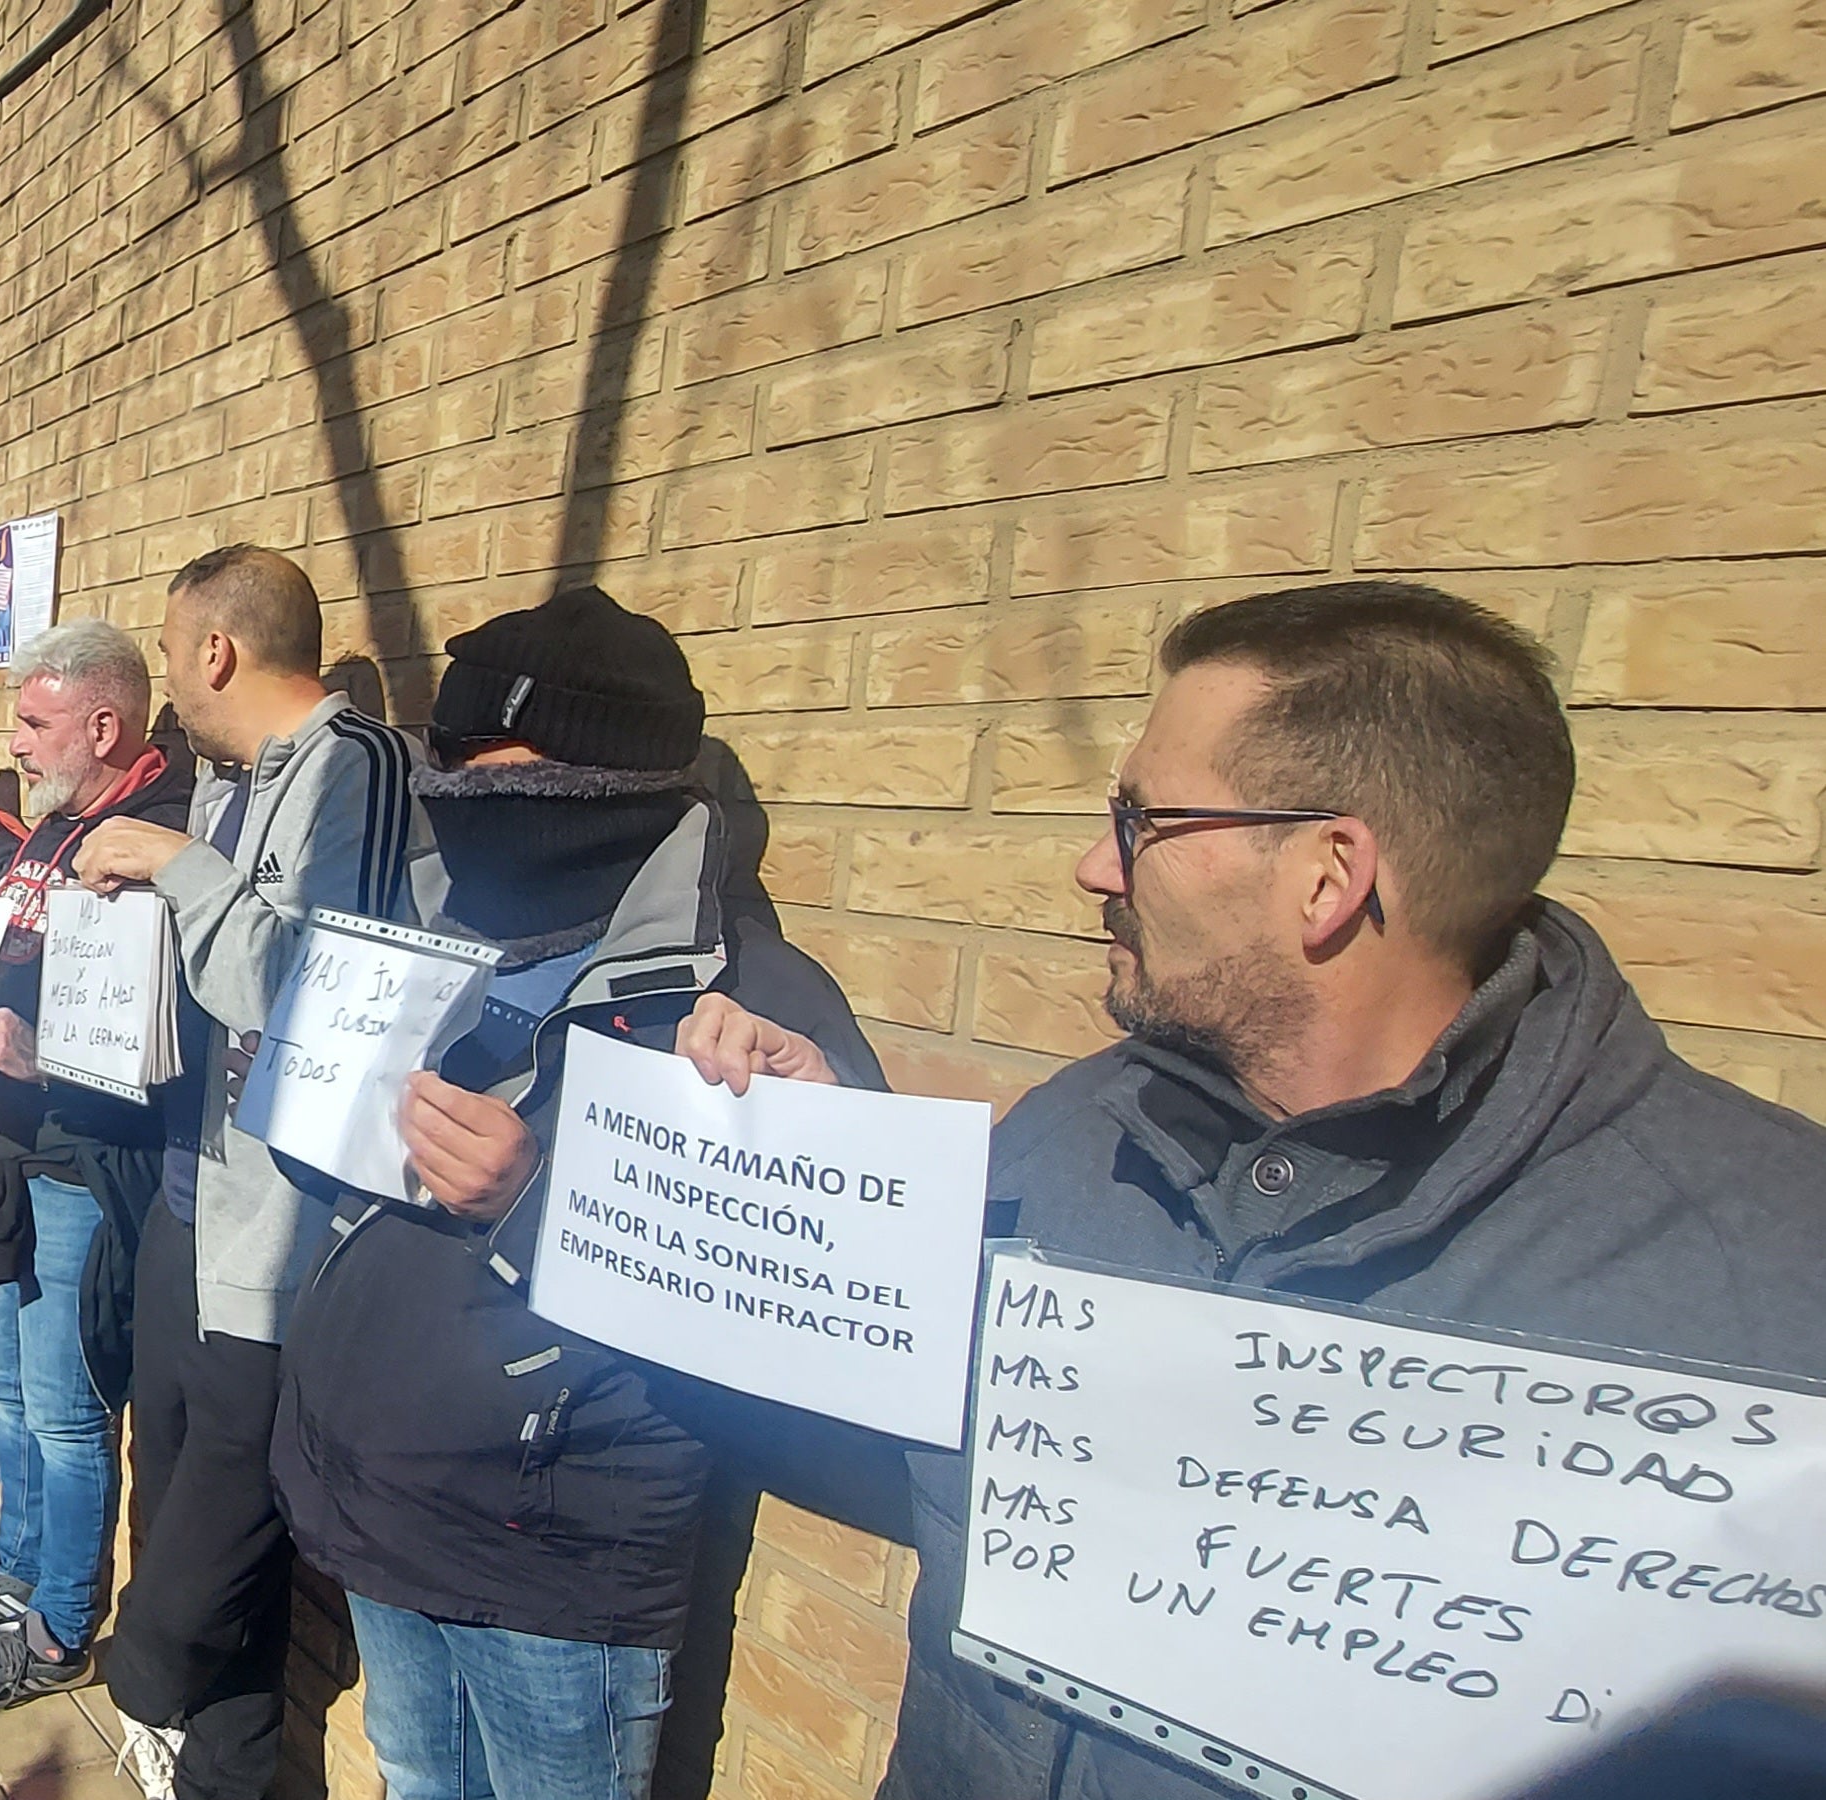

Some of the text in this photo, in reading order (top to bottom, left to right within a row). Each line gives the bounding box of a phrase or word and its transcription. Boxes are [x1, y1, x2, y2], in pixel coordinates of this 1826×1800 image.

[51, 982, 88, 1007] MENOS
[292, 948, 349, 991] MAS
[40, 1019, 54, 1040] EN
[63, 1022, 78, 1043] LA
[267, 1036, 342, 1083] TODOS
[584, 1102, 907, 1208] A MENOR TAMAÑO DE
[613, 1157, 836, 1253] LA INSPECCIÓN,
[560, 1229, 915, 1354] EMPRESARIO INFRACTOR
[568, 1189, 911, 1310] MAYOR LA SONRISA DEL
[988, 1354, 1080, 1393] MAS
[995, 1279, 1778, 1446] MAS INSPECTOR@S
[980, 1477, 1532, 1644] MAS FUERTES
[986, 1414, 1826, 1620] MAS DEFENSA DERECHOS
[981, 1528, 1076, 1582] POR
[1127, 1572, 1217, 1618] UN
[1247, 1607, 1500, 1700] EMPLEO
